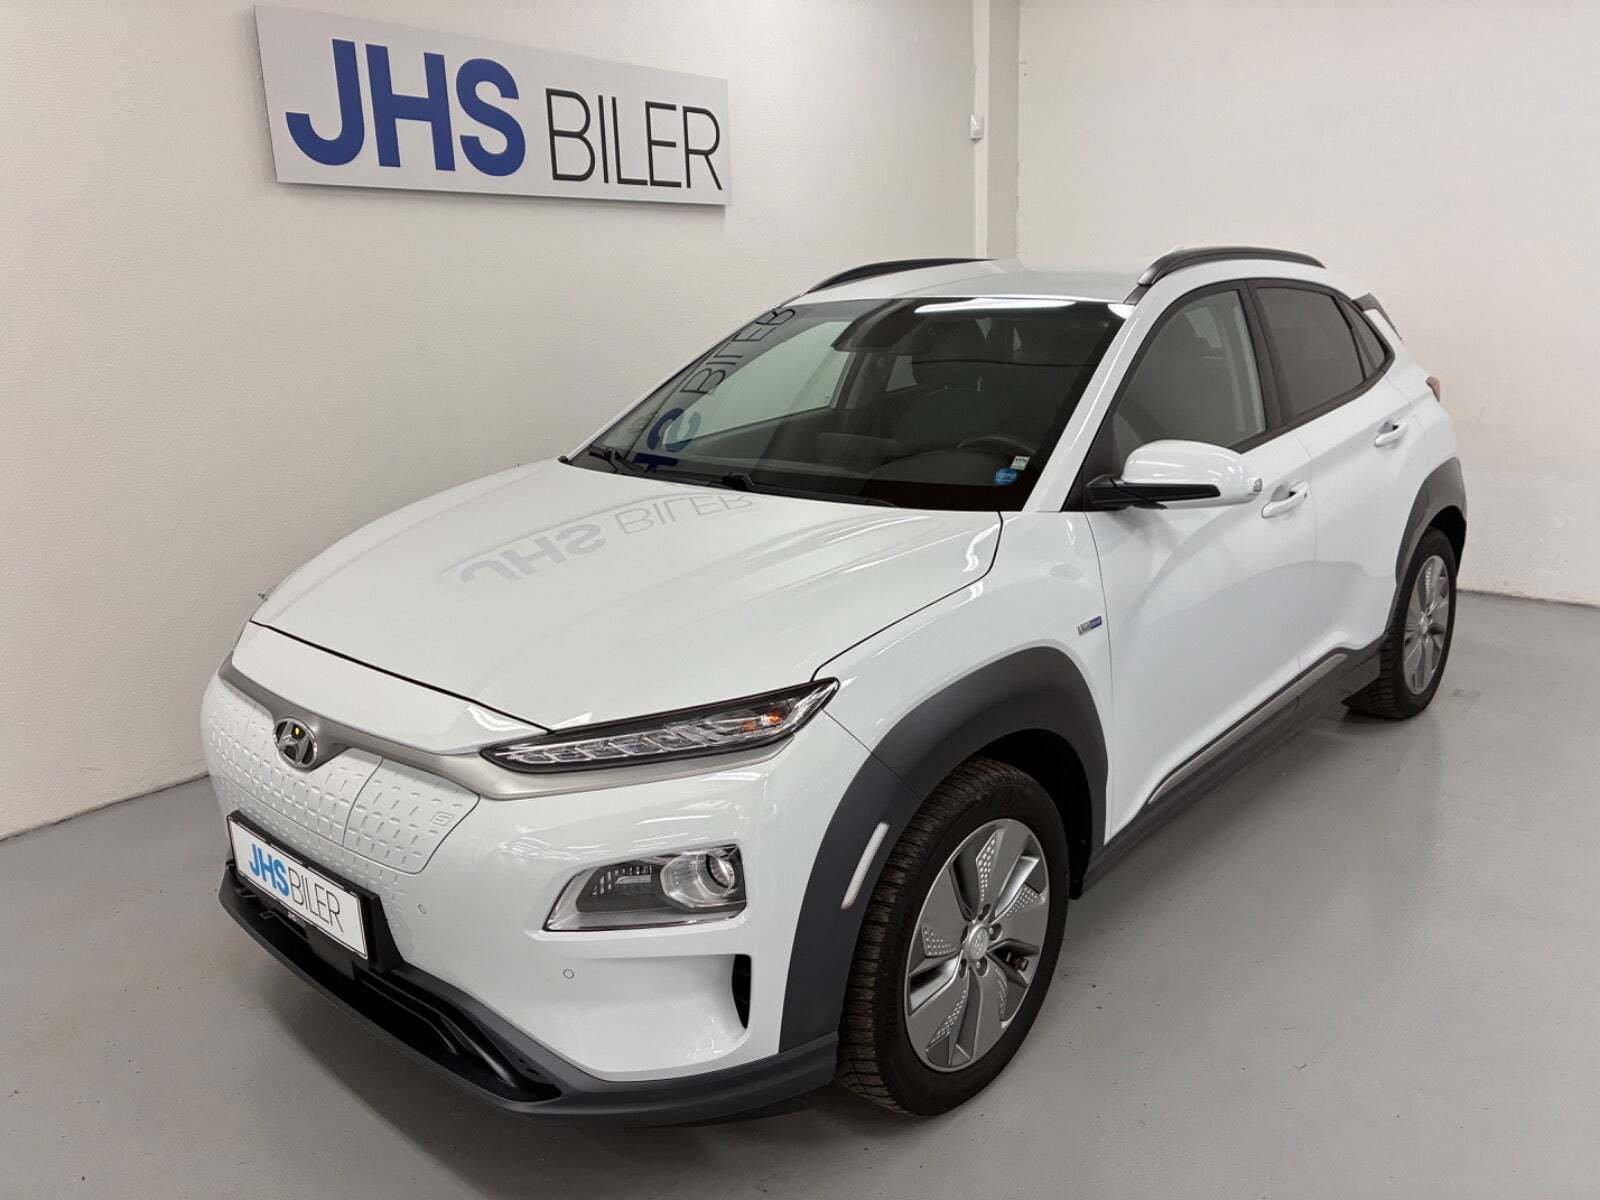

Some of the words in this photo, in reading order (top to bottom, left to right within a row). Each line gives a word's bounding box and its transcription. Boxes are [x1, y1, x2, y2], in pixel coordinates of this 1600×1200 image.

[286, 38, 526, 177] JHS
[545, 88, 723, 190] BILER
[249, 843, 290, 897] JHS
[288, 866, 344, 933] BILER
